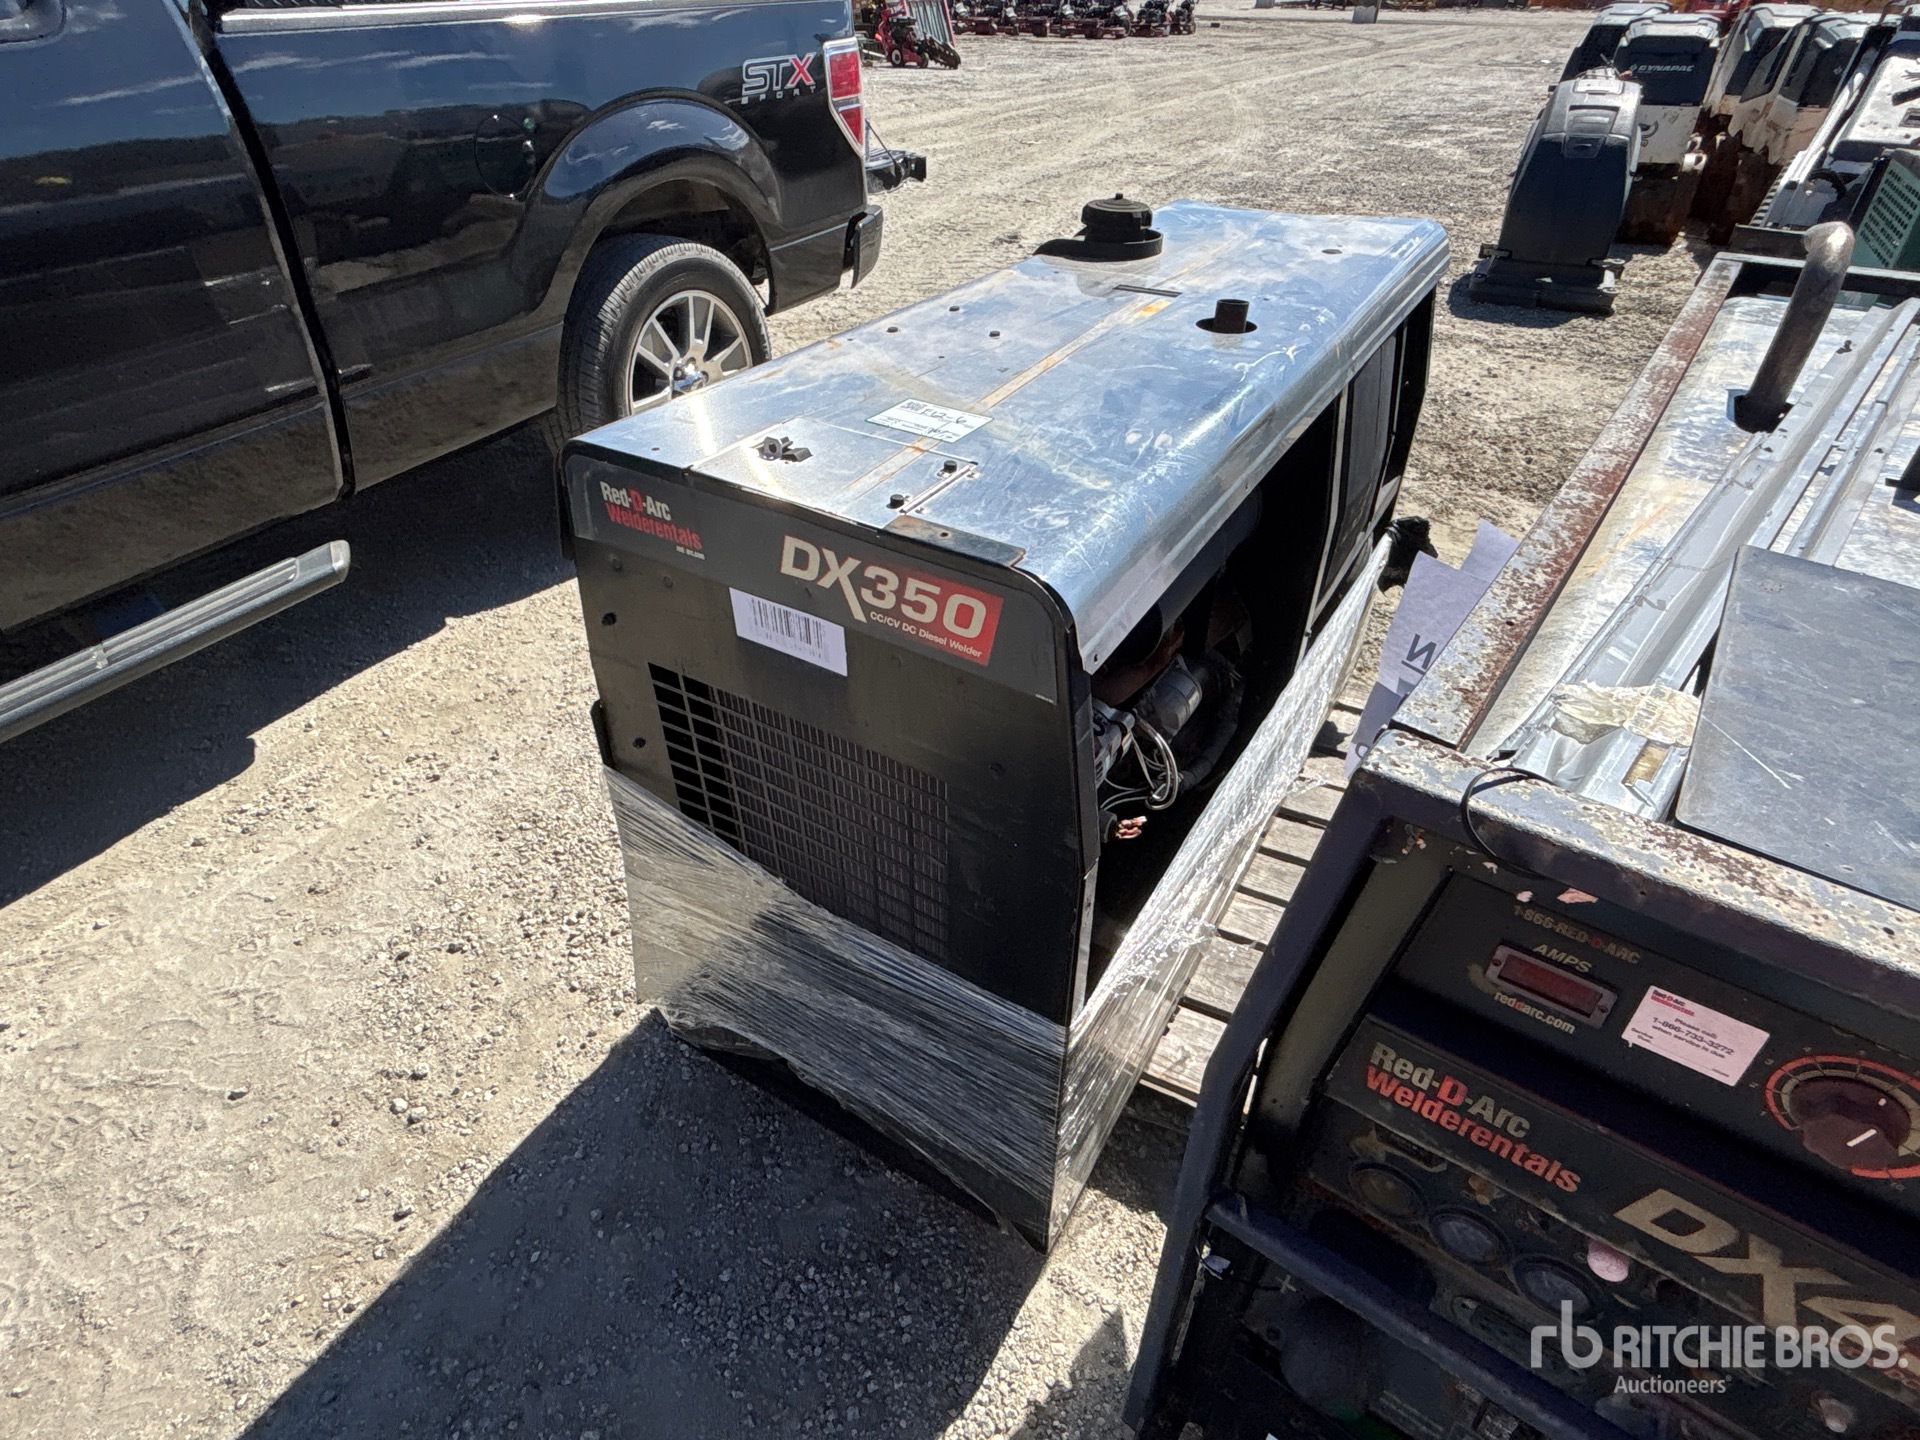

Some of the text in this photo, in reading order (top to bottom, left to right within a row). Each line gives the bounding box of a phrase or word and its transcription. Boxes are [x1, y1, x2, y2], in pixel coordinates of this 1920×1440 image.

[742, 52, 817, 95] STX
[1638, 64, 1695, 72] DYNAPAC
[600, 481, 672, 521] Red-D-Arc
[605, 502, 703, 550] Welderentals
[780, 534, 987, 639] DX350
[870, 611, 982, 658] CC/CV DC Diesel Welder
[1532, 944, 1593, 973] AMPS
[1652, 1025, 1672, 1036] when
[1673, 1031, 1701, 1048] service
[1710, 1049, 1726, 1059] due
[1653, 1017, 1735, 1056] 1-866-733-3272
[1370, 1041, 1531, 1138] Red-D-Arc
[1366, 1065, 1582, 1193] Welderentals
